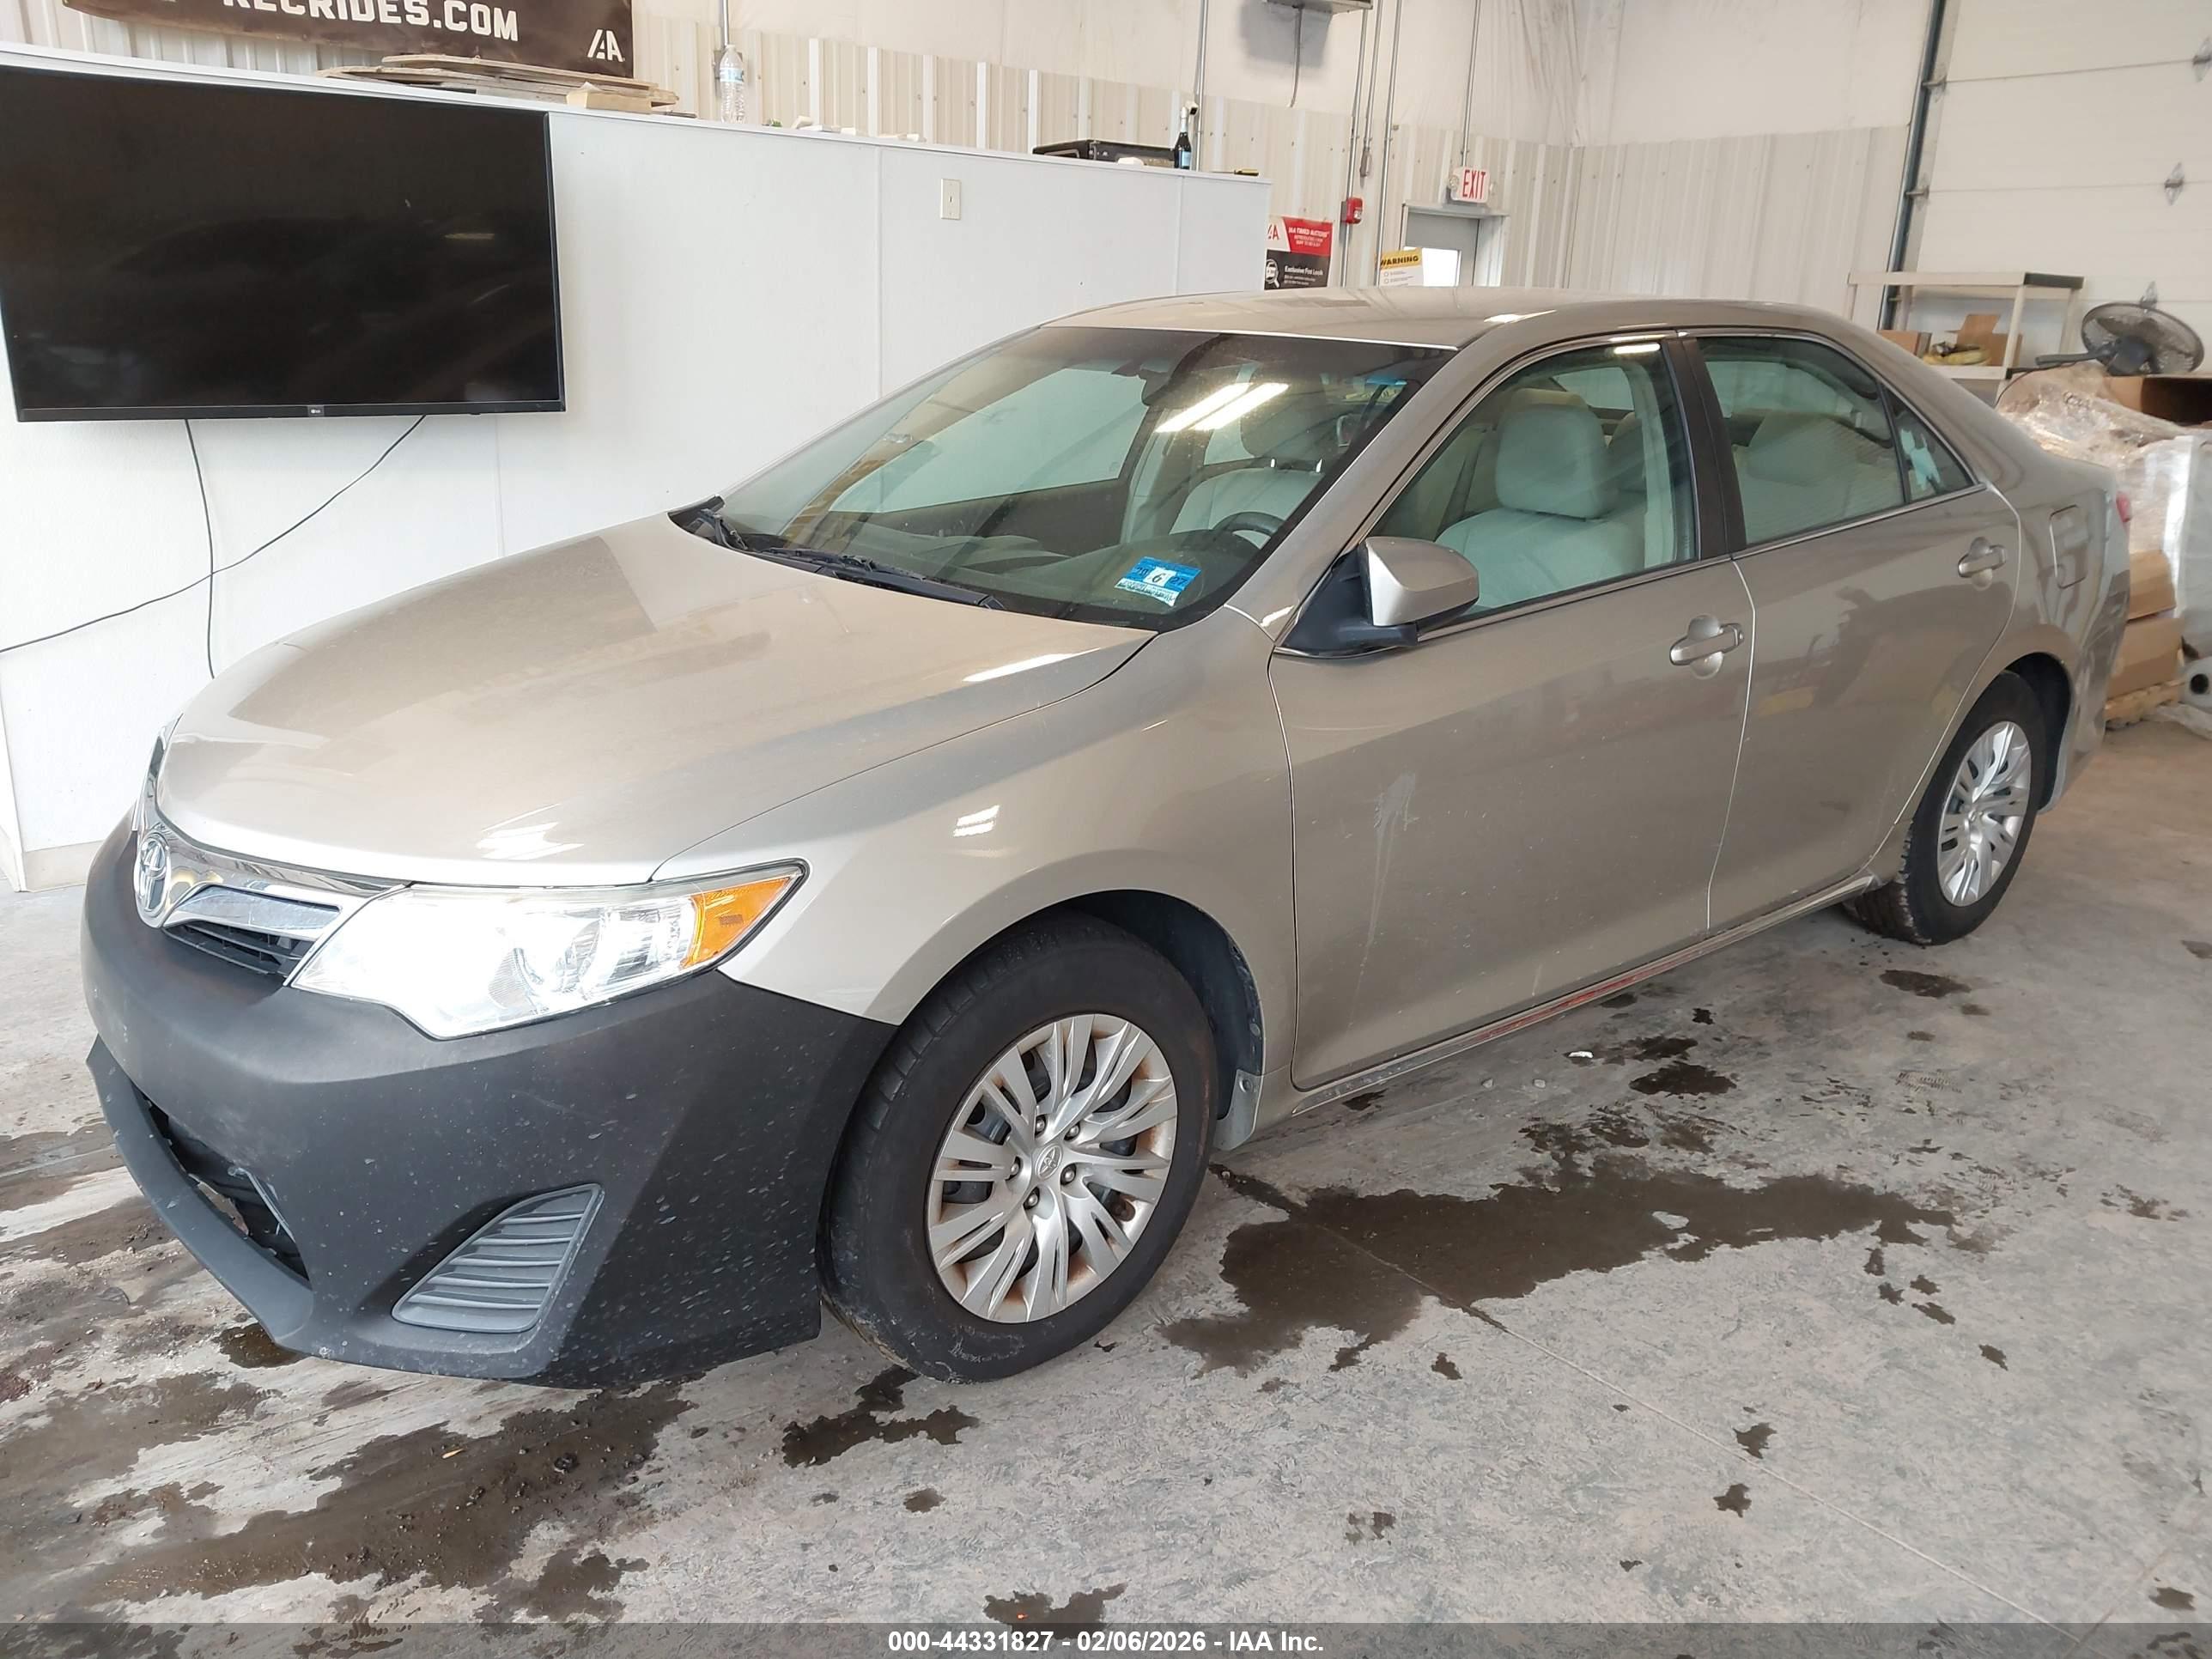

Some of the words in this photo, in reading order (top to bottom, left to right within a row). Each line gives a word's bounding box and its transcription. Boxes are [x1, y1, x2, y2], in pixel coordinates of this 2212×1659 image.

[1462, 169, 1486, 199] EXIT
[1380, 255, 1419, 266] WARNING
[1152, 573, 1166, 583] 6
[1169, 575, 1188, 586] 27
